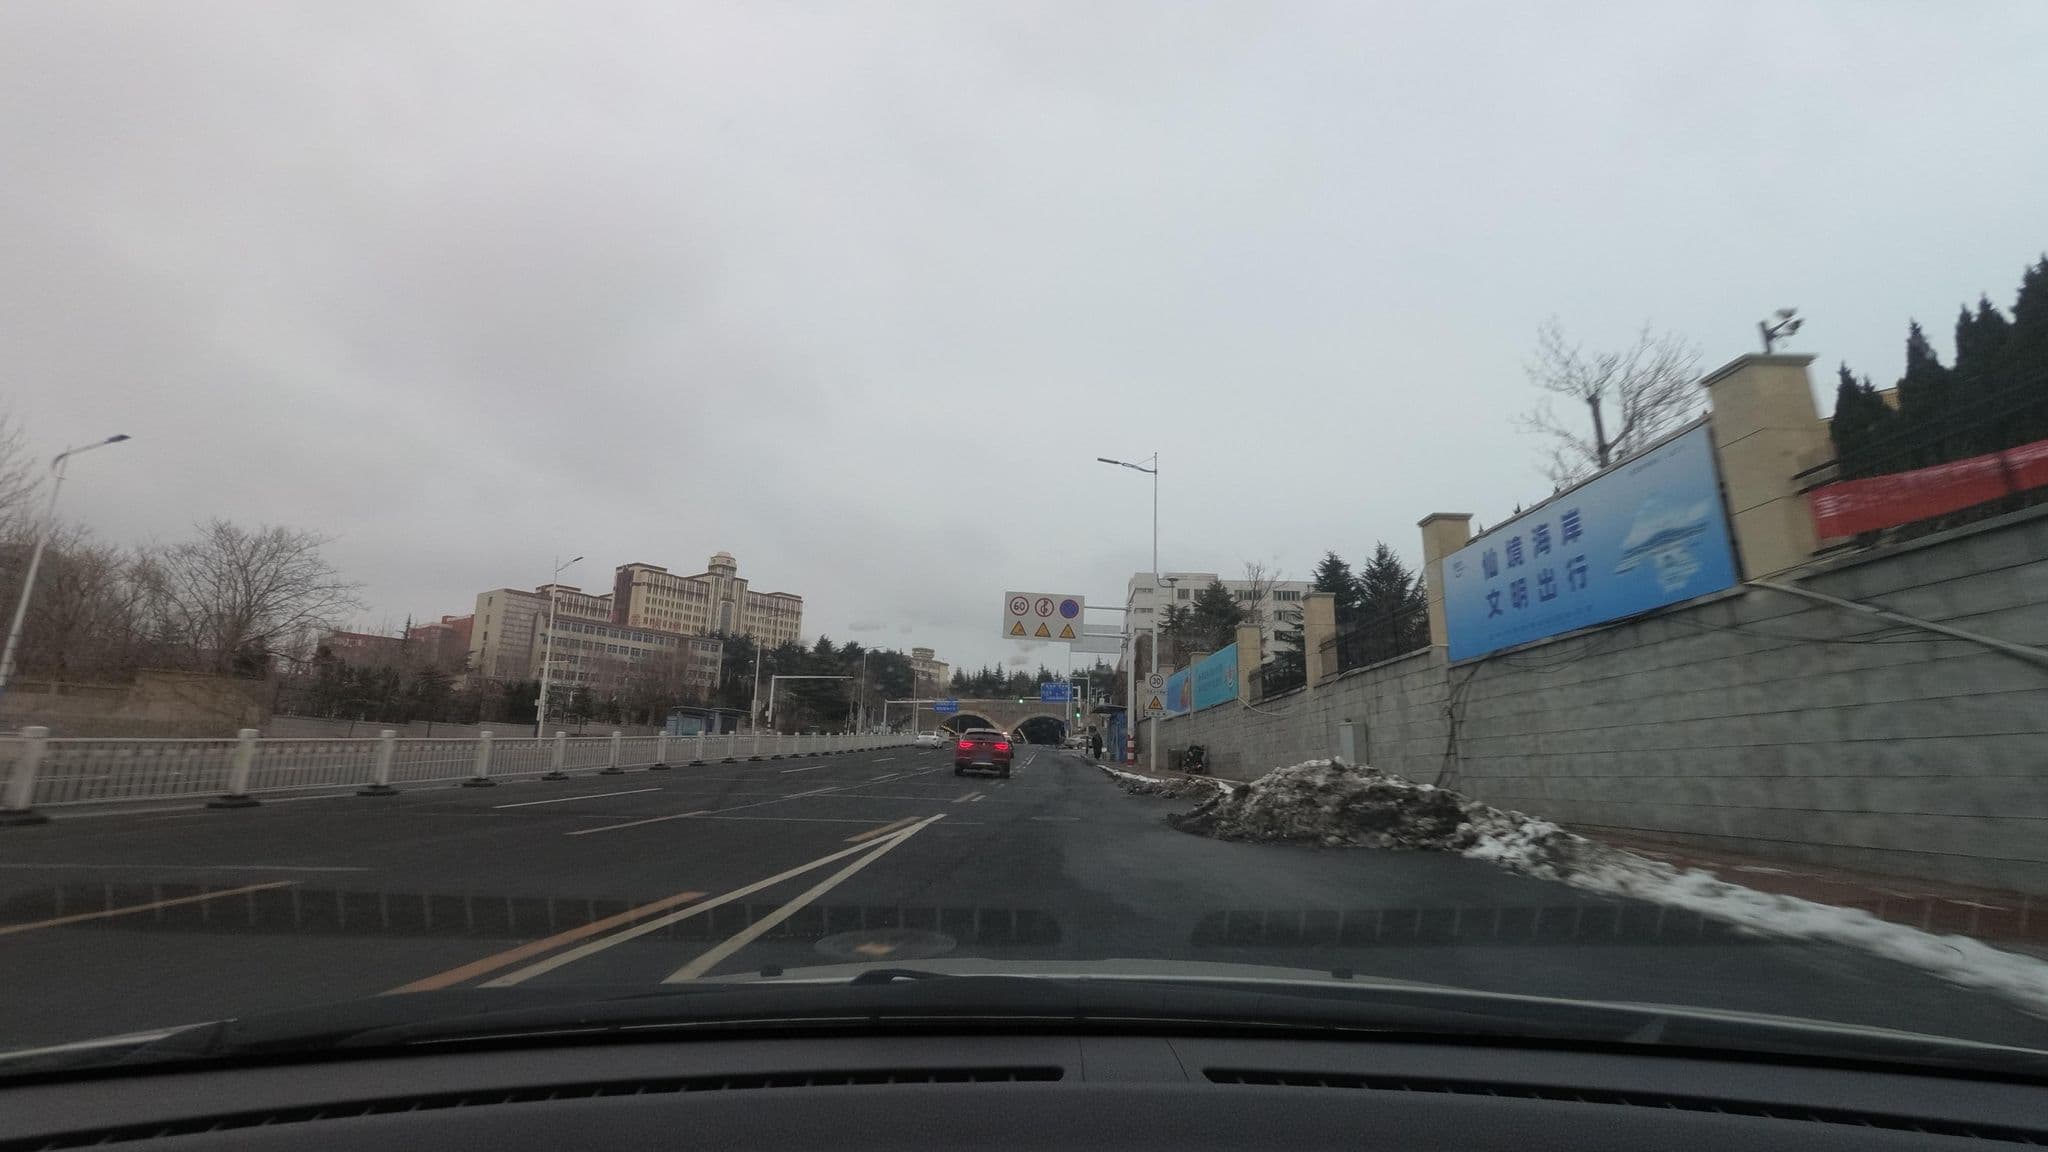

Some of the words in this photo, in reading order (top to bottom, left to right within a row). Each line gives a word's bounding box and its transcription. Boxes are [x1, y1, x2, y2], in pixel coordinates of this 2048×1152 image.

[1486, 554, 1587, 619] 文明出行
[1014, 601, 1025, 611] 60
